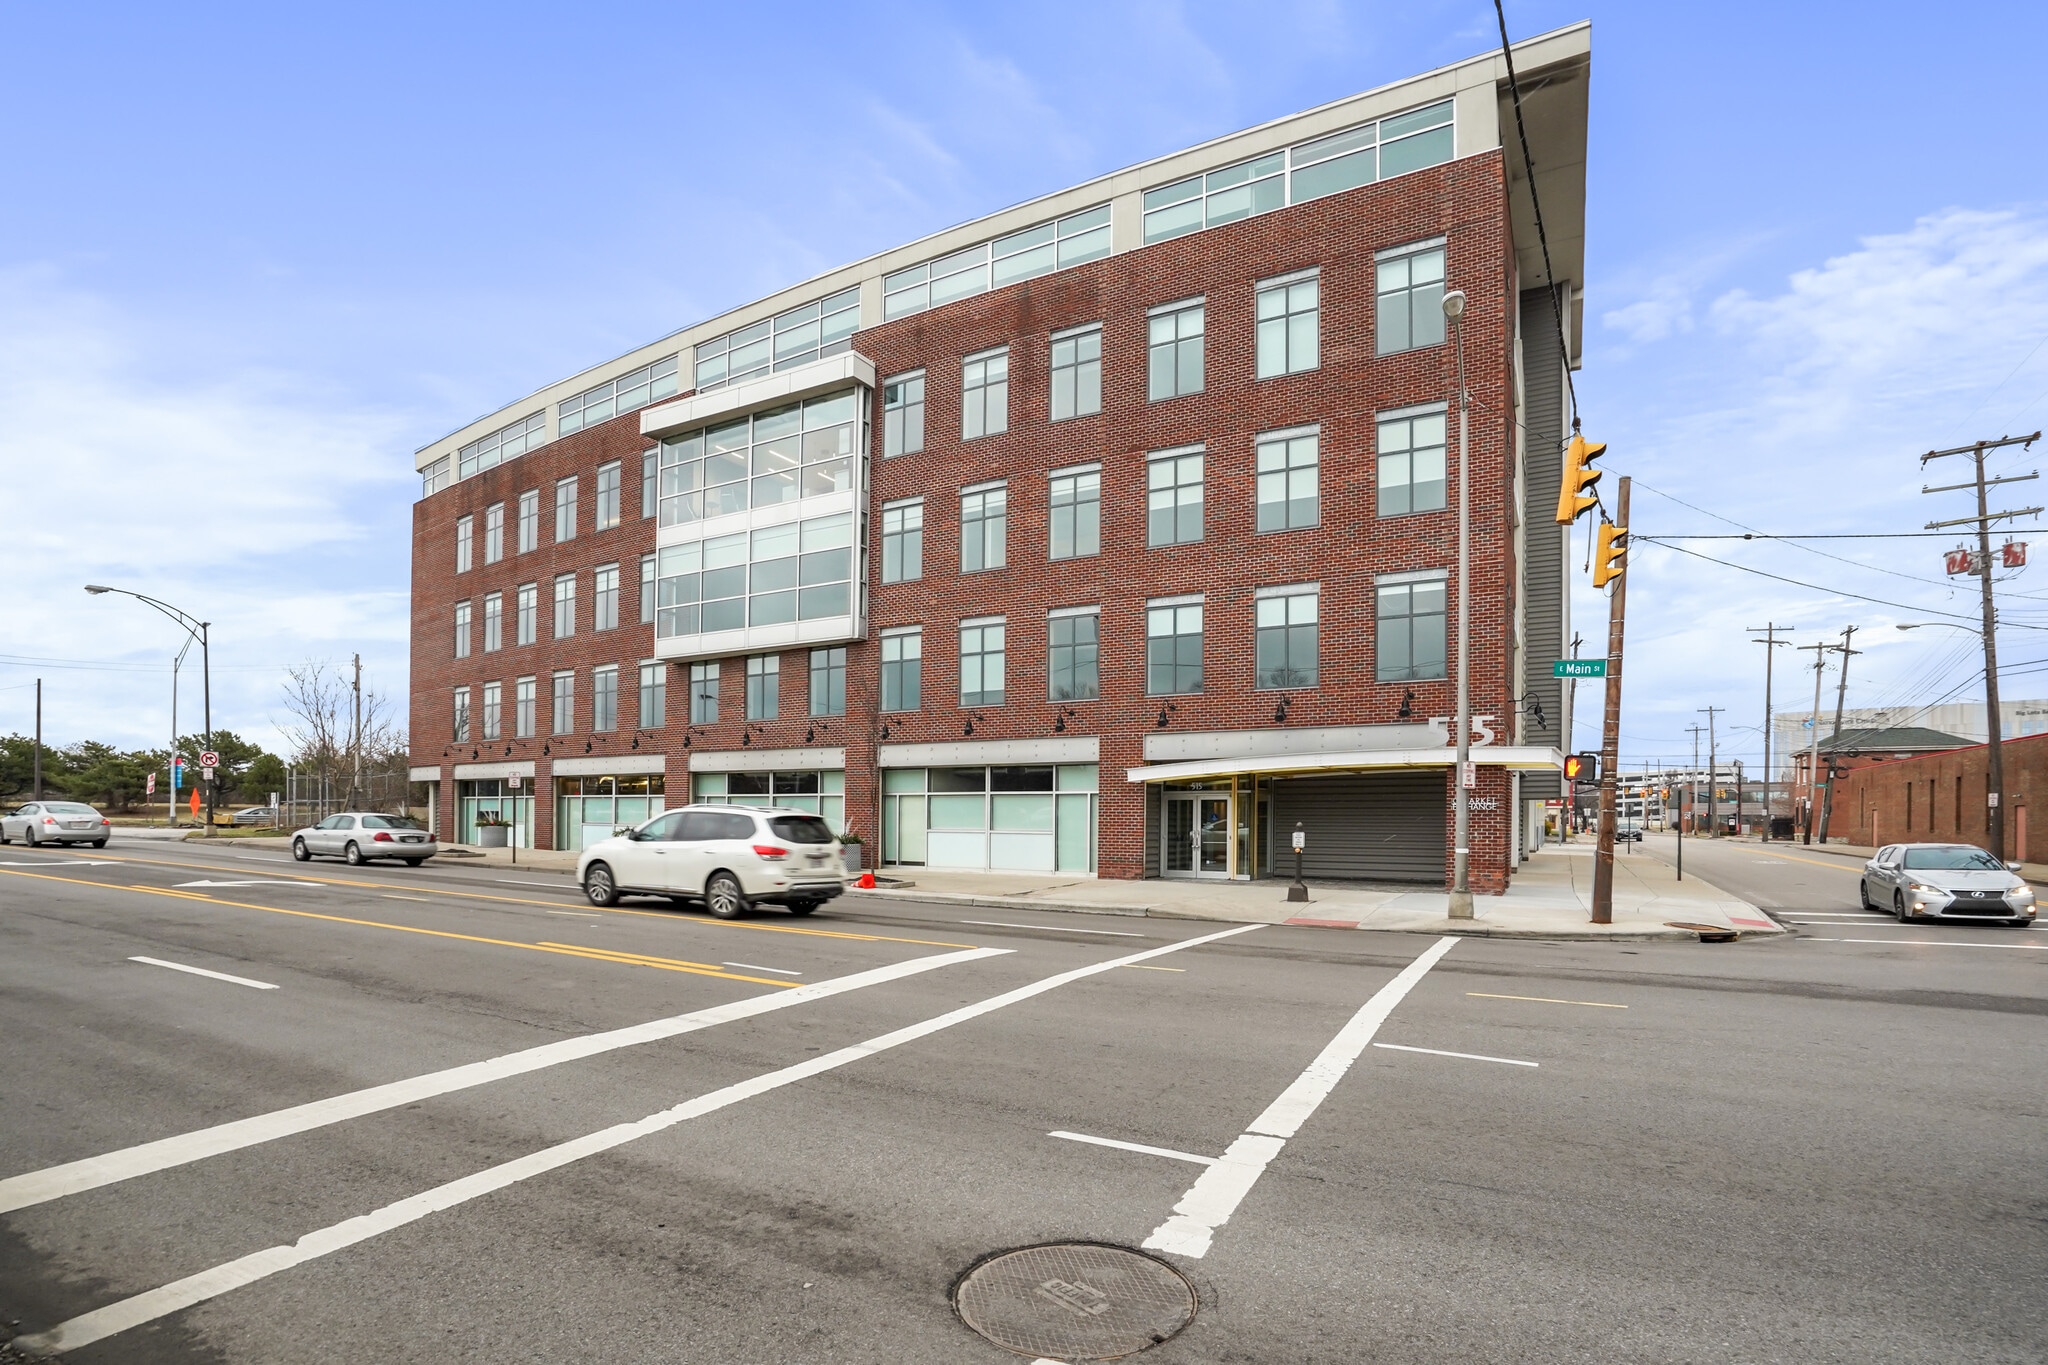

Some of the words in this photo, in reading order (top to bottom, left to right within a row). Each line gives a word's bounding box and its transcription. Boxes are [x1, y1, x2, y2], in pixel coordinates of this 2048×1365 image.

[1566, 663, 1591, 674] Main
[1428, 715, 1495, 748] 55
[1191, 782, 1203, 790] 515
